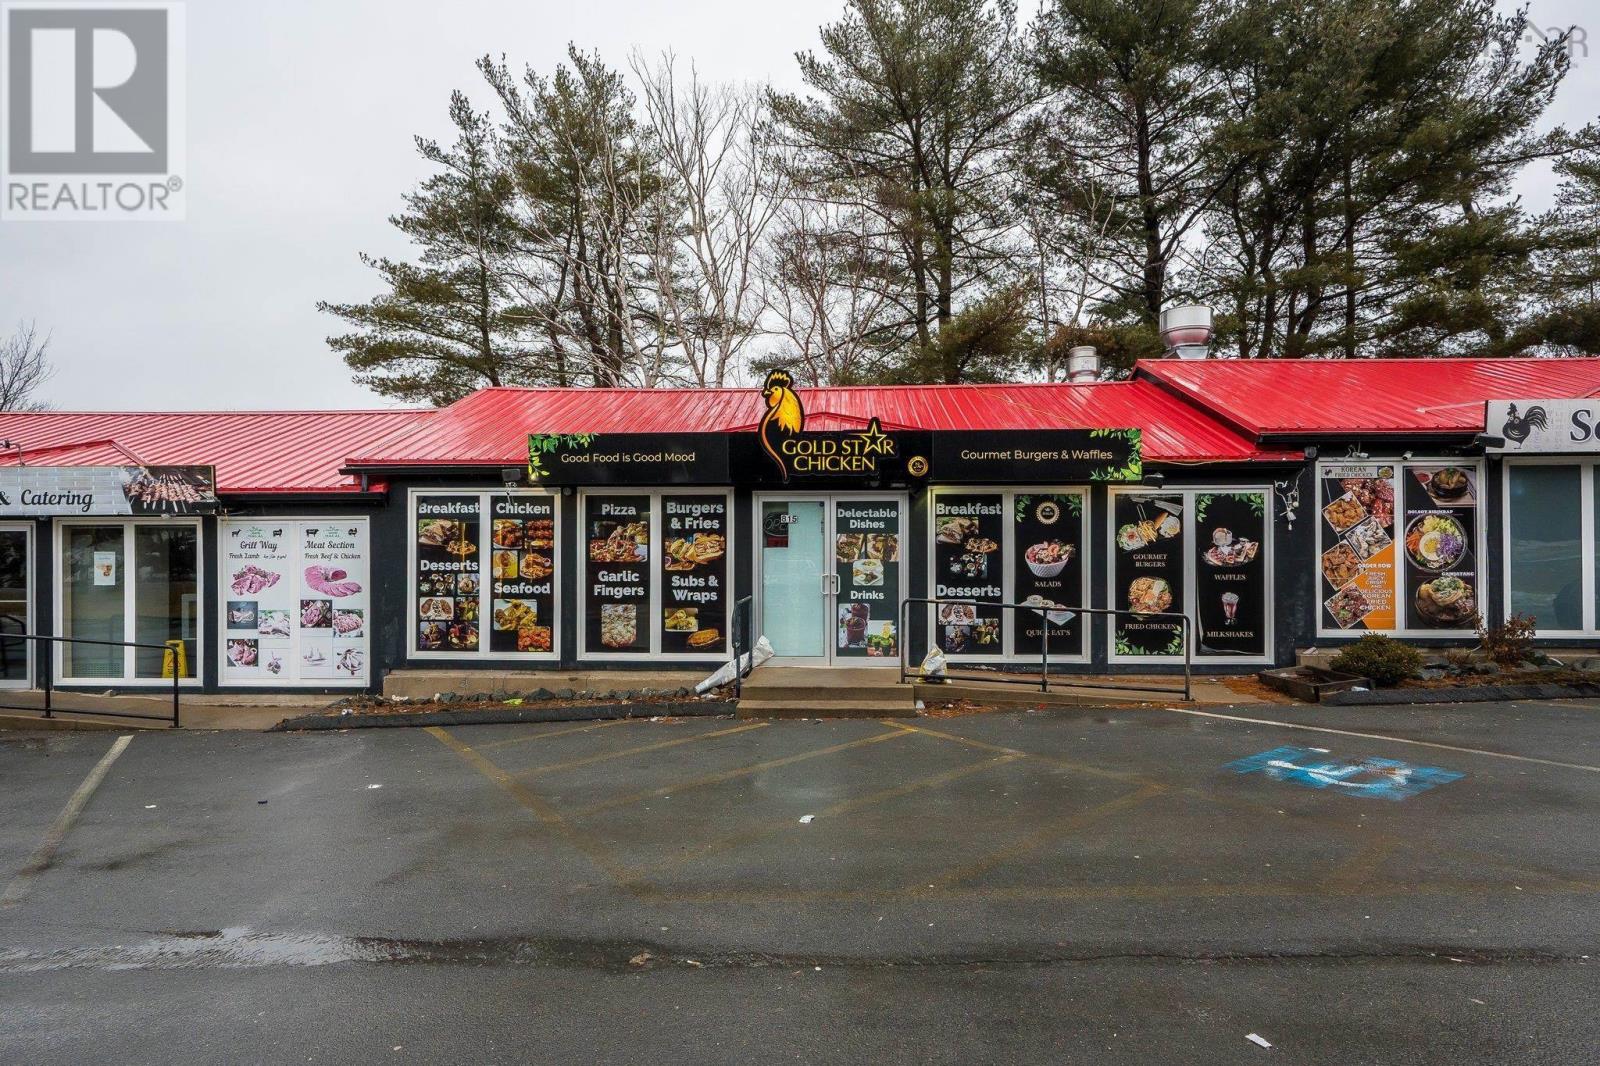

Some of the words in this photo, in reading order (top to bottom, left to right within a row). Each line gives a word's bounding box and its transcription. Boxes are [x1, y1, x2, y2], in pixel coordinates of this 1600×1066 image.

[1570, 409, 1600, 441] S
[782, 440, 836, 455] GOLD
[561, 453, 590, 463] Good
[593, 453, 620, 463] Food
[622, 453, 631, 463] is
[633, 452, 662, 462] Good
[665, 452, 696, 462] Mood
[961, 450, 1011, 460] Gourmet
[1014, 450, 1059, 461] Burgers
[1061, 450, 1069, 460] &
[1072, 450, 1113, 460] Waffles
[794, 456, 875, 471] CHICKEN
[21, 489, 95, 512] Catering
[418, 502, 480, 514] Breakfast
[496, 502, 550, 514] Chicken
[601, 504, 637, 515] Pizza
[666, 502, 724, 517] Burgers
[837, 508, 898, 518] Delectable
[935, 503, 1002, 515] Breakfast
[671, 517, 682, 529] &
[685, 517, 720, 529] Fries
[781, 515, 798, 524] 815
[850, 519, 885, 529] Dishes
[240, 541, 258, 549] Grill
[259, 541, 278, 552] Way
[304, 541, 325, 549] Meat
[327, 540, 355, 549] Section
[420, 560, 479, 571] Desserts
[598, 571, 640, 582] Garlic
[671, 575, 705, 587] Subs
[708, 575, 719, 587] &
[494, 582, 551, 594] Seafood
[593, 585, 645, 599] Fingers
[936, 584, 1002, 597] Desserts
[673, 589, 718, 603] Wraps
[850, 590, 885, 600] Drinks
